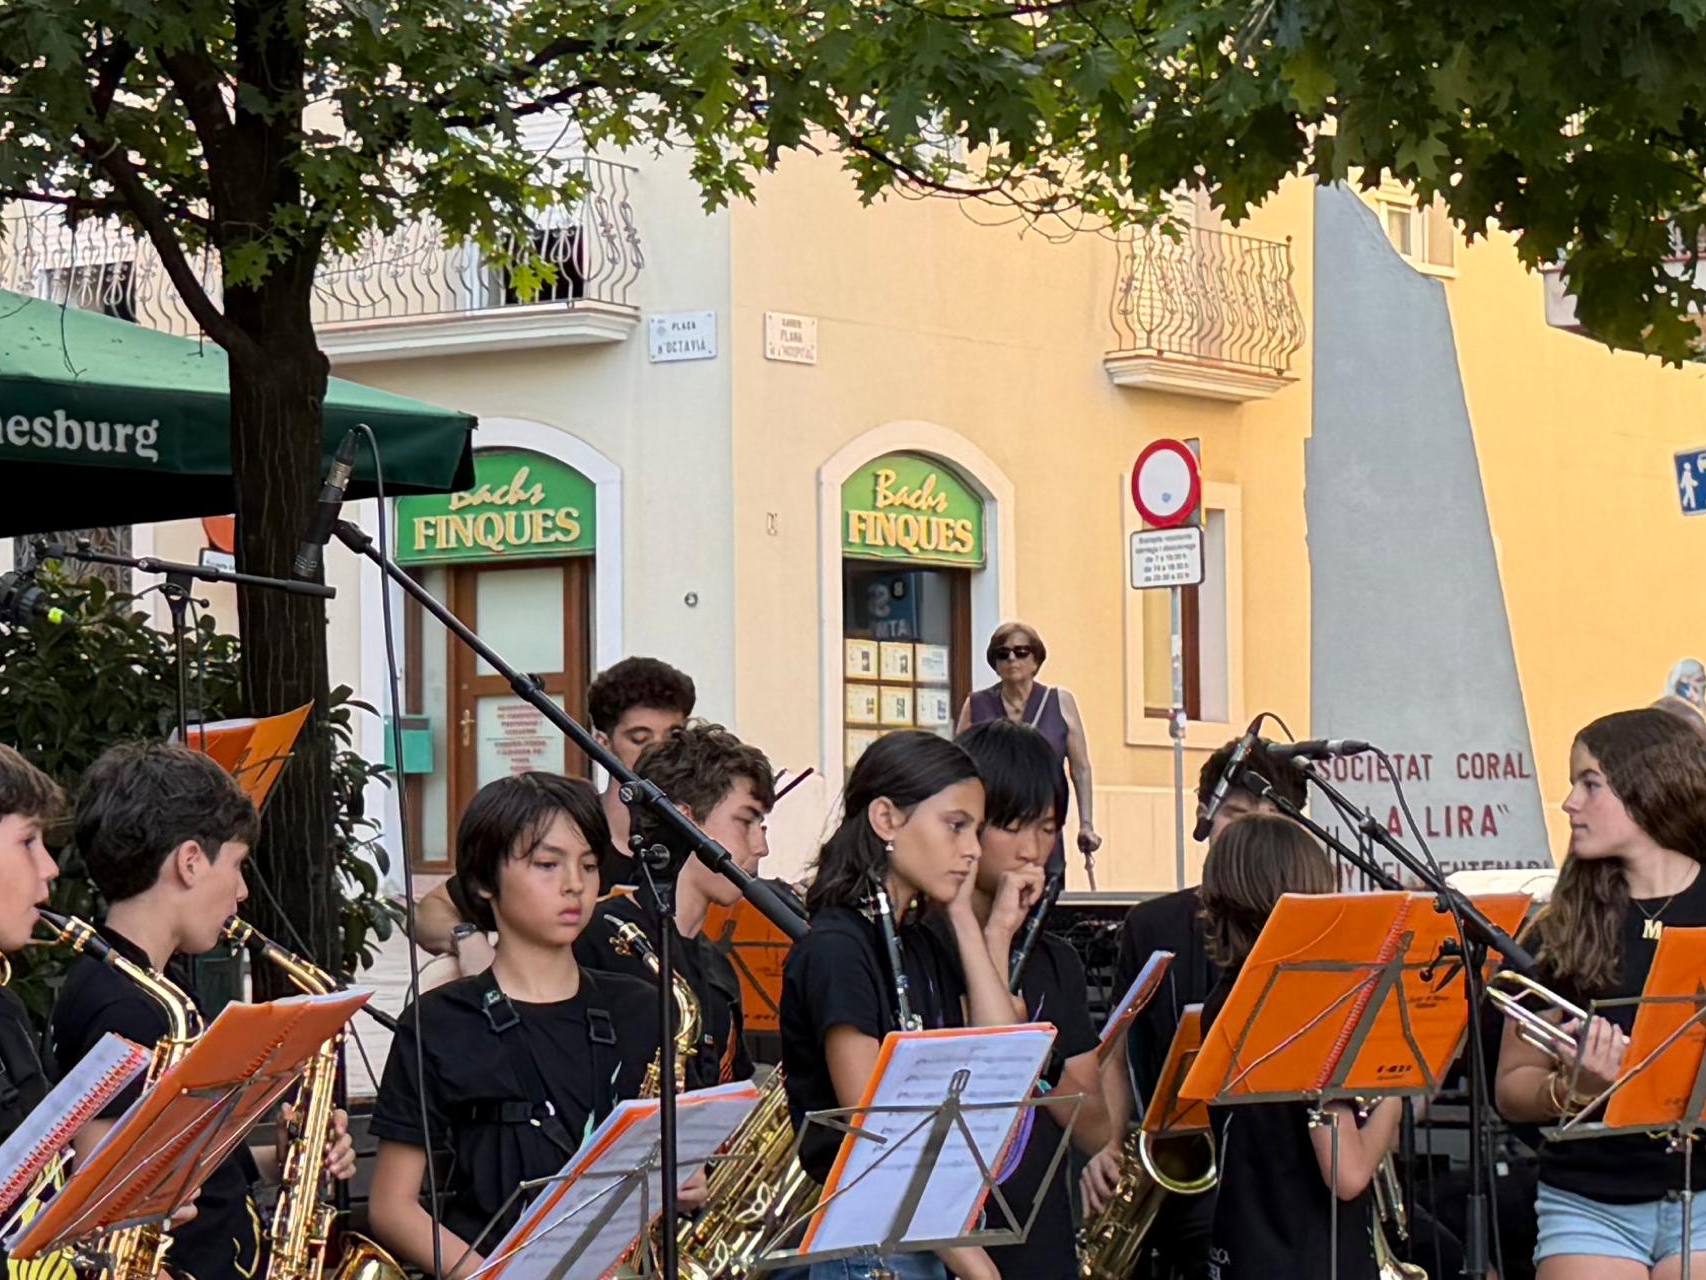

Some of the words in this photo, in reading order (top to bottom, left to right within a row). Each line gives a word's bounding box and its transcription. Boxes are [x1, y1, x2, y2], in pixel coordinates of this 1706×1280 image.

[874, 468, 949, 513] Bachs
[413, 507, 581, 551] FINQUES
[847, 509, 975, 554] FINQUES
[1456, 751, 1531, 780] CORAL
